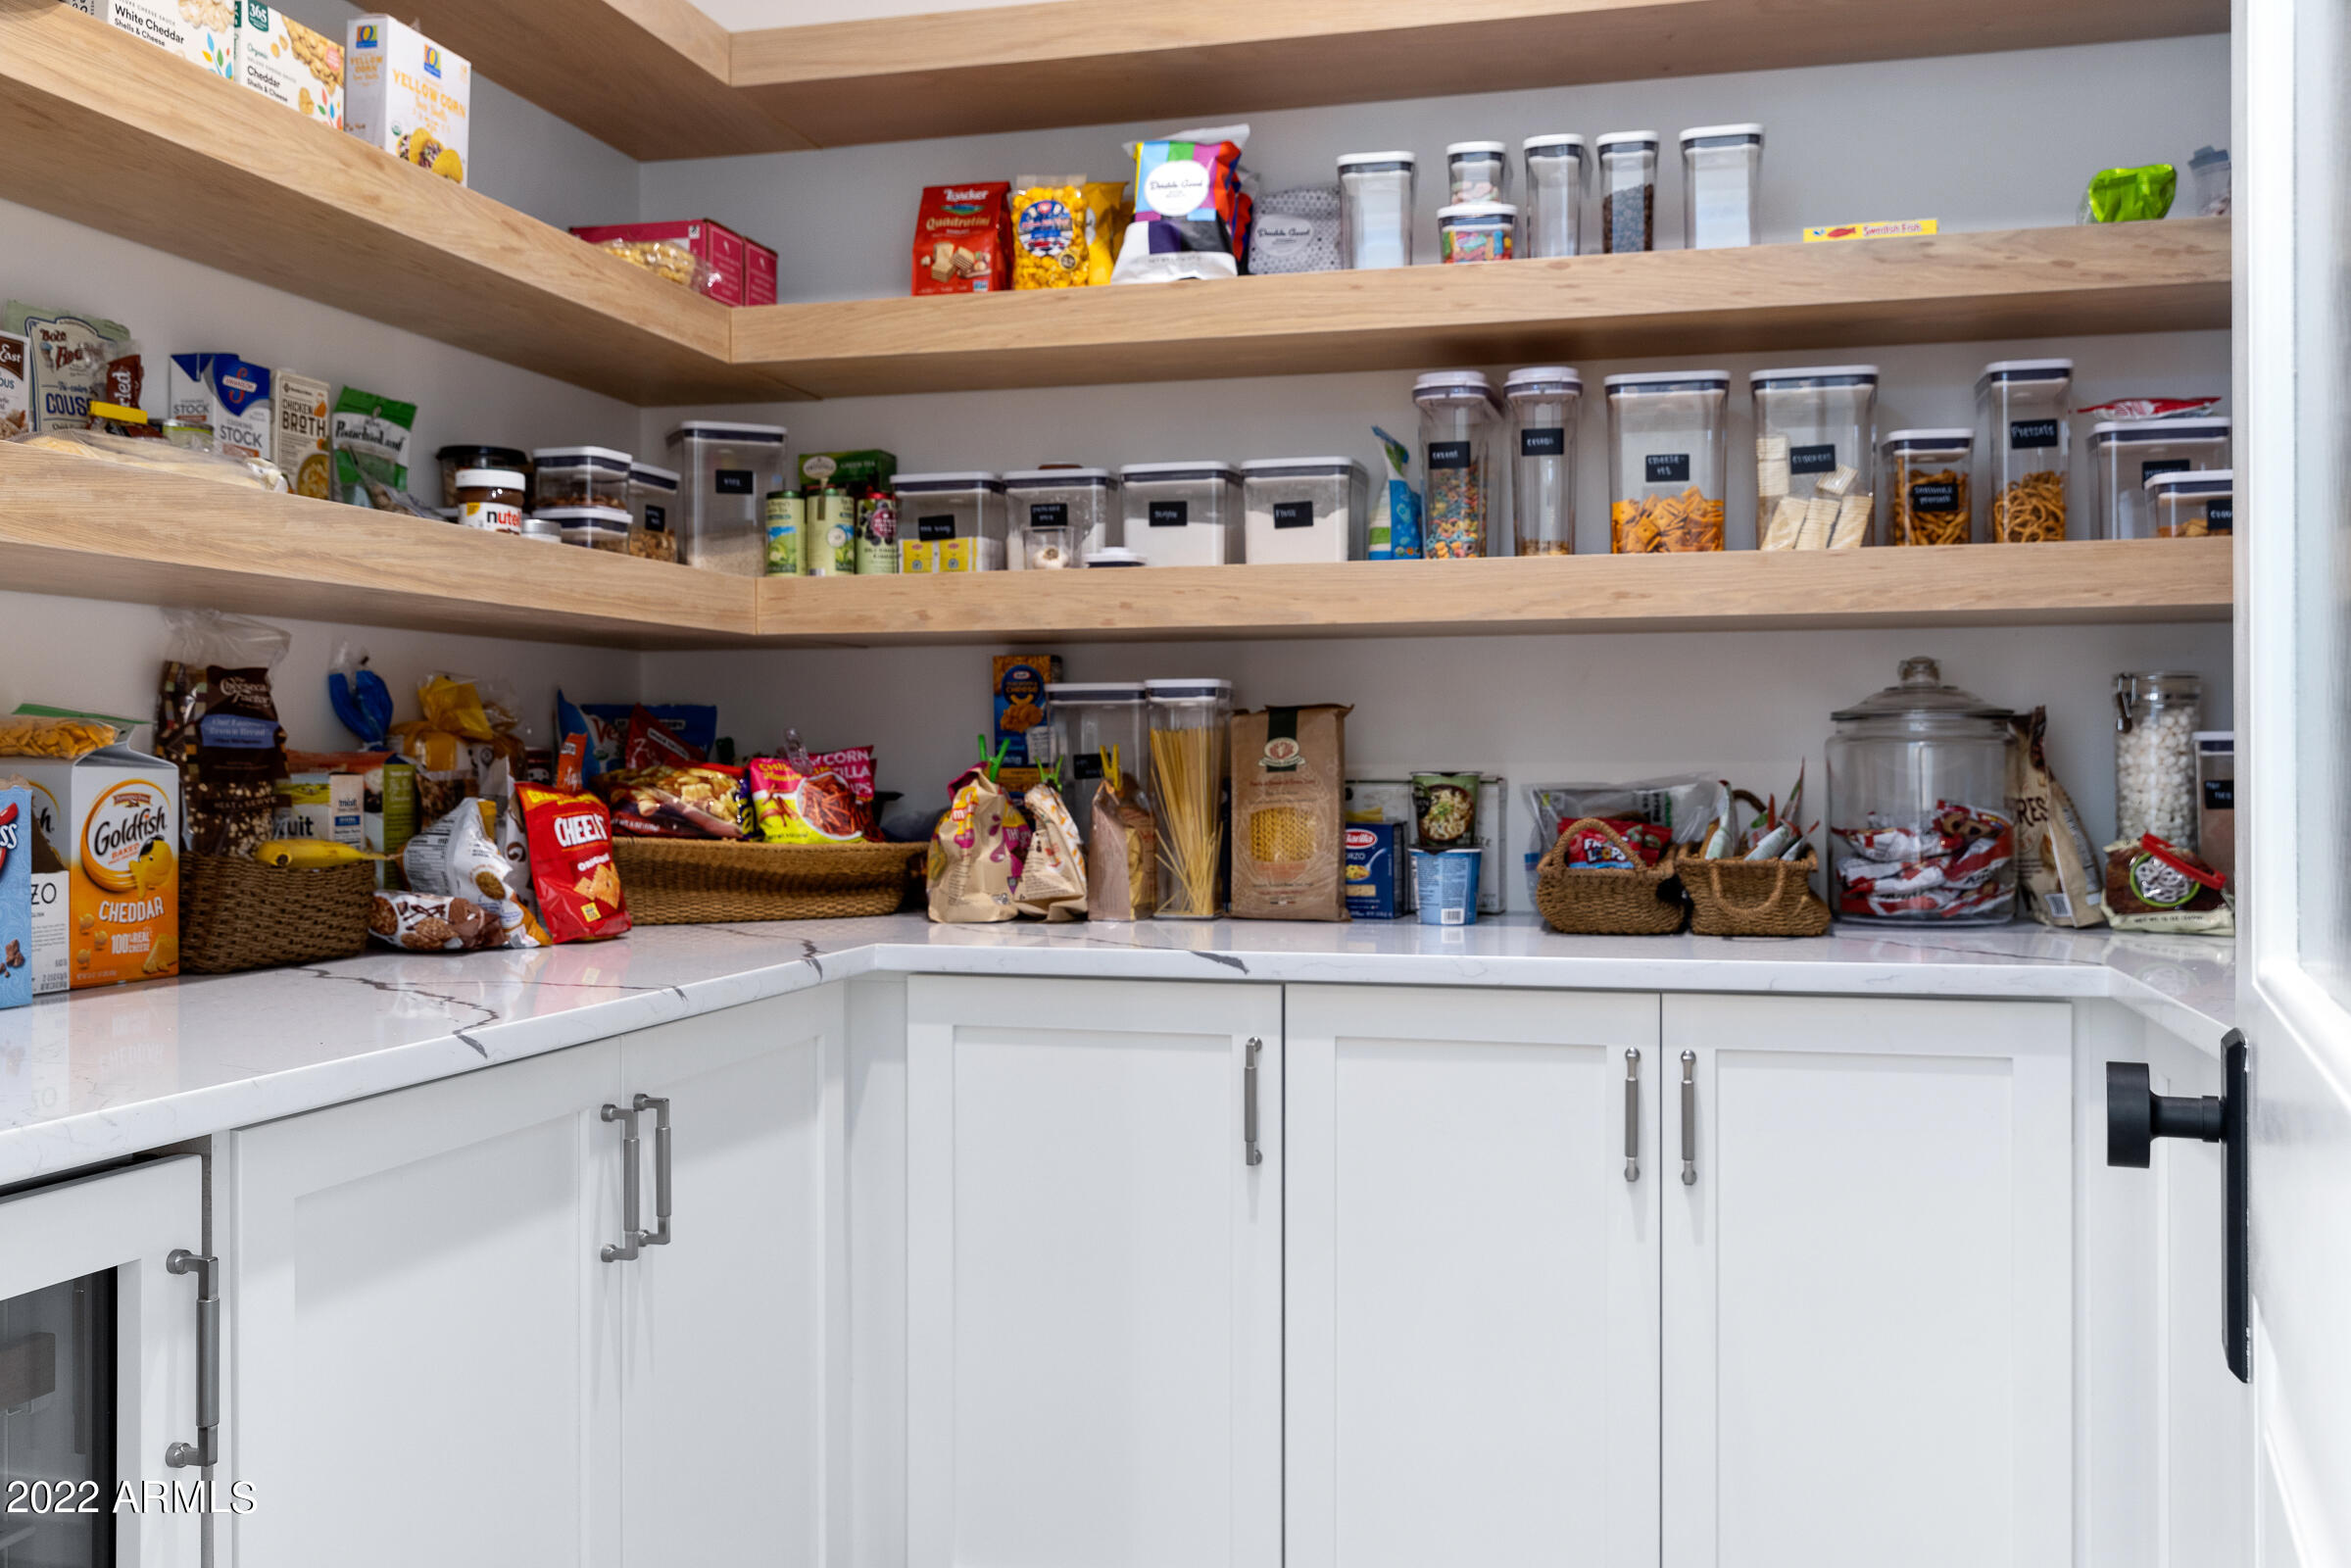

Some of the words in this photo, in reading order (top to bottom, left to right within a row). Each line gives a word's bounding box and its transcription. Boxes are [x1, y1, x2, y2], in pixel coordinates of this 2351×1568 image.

[115, 4, 144, 25] White
[146, 19, 184, 44] Cheddar
[249, 4, 268, 23] 365
[114, 18, 134, 33] Shells
[141, 30, 166, 47] Cheese
[247, 65, 280, 88] Cheddar
[393, 69, 437, 103] YELLOW
[440, 93, 466, 120] CORN
[0, 343, 22, 364] East
[173, 403, 210, 416] STOCK
[282, 398, 314, 416] CHICKEN
[220, 425, 263, 449] STOCK
[282, 411, 326, 439] BROTH
[824, 750, 869, 764] CORN
[95, 805, 165, 857] Goldfish
[99, 897, 165, 923] CHEDDAR
